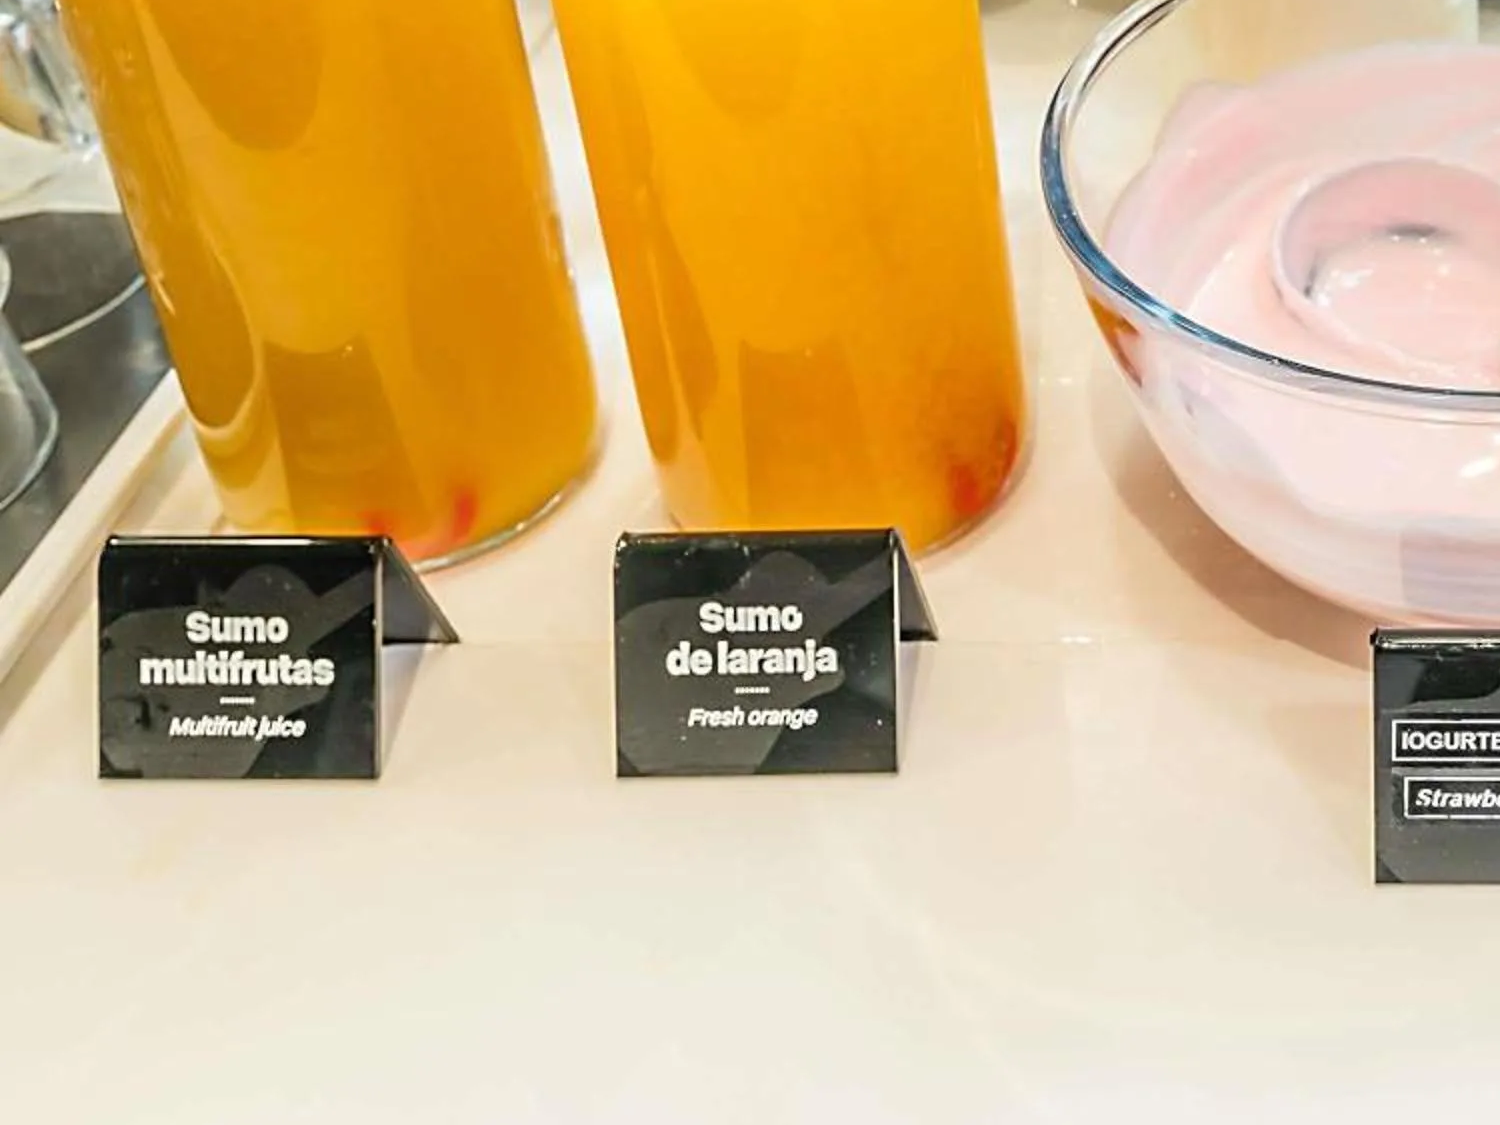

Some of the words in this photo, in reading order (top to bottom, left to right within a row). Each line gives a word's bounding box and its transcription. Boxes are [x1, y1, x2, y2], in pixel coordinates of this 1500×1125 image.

[184, 610, 290, 644] Sumo
[699, 601, 803, 634] Sumo
[138, 650, 336, 687] multifrutas
[665, 641, 713, 676] de
[717, 639, 839, 682] laranja
[169, 715, 257, 738] Multifruit
[254, 715, 307, 741] juice
[687, 706, 746, 728] Fresh
[748, 708, 819, 730] orange
